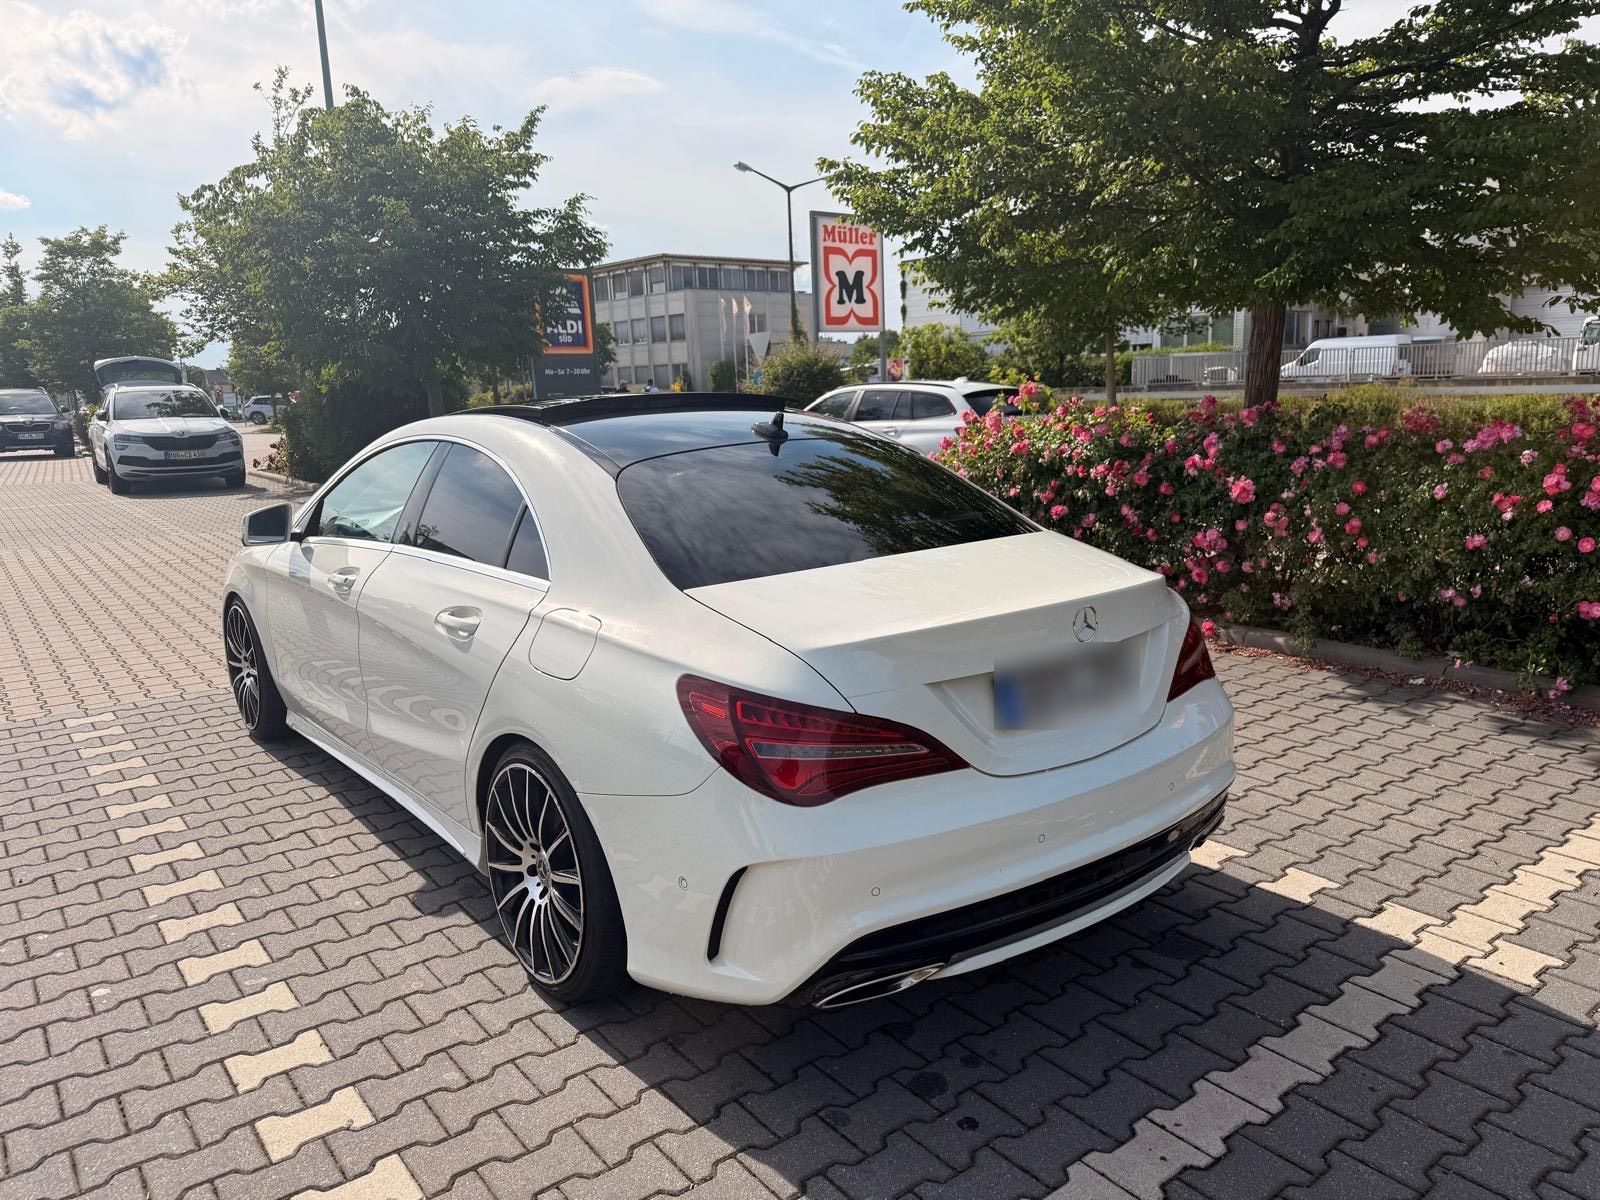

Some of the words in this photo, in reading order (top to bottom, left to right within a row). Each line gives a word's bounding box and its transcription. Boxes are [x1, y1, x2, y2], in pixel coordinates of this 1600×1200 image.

[823, 224, 876, 245] Müller
[835, 270, 866, 304] M
[546, 319, 583, 334] ALDI
[558, 334, 573, 343] SÜD
